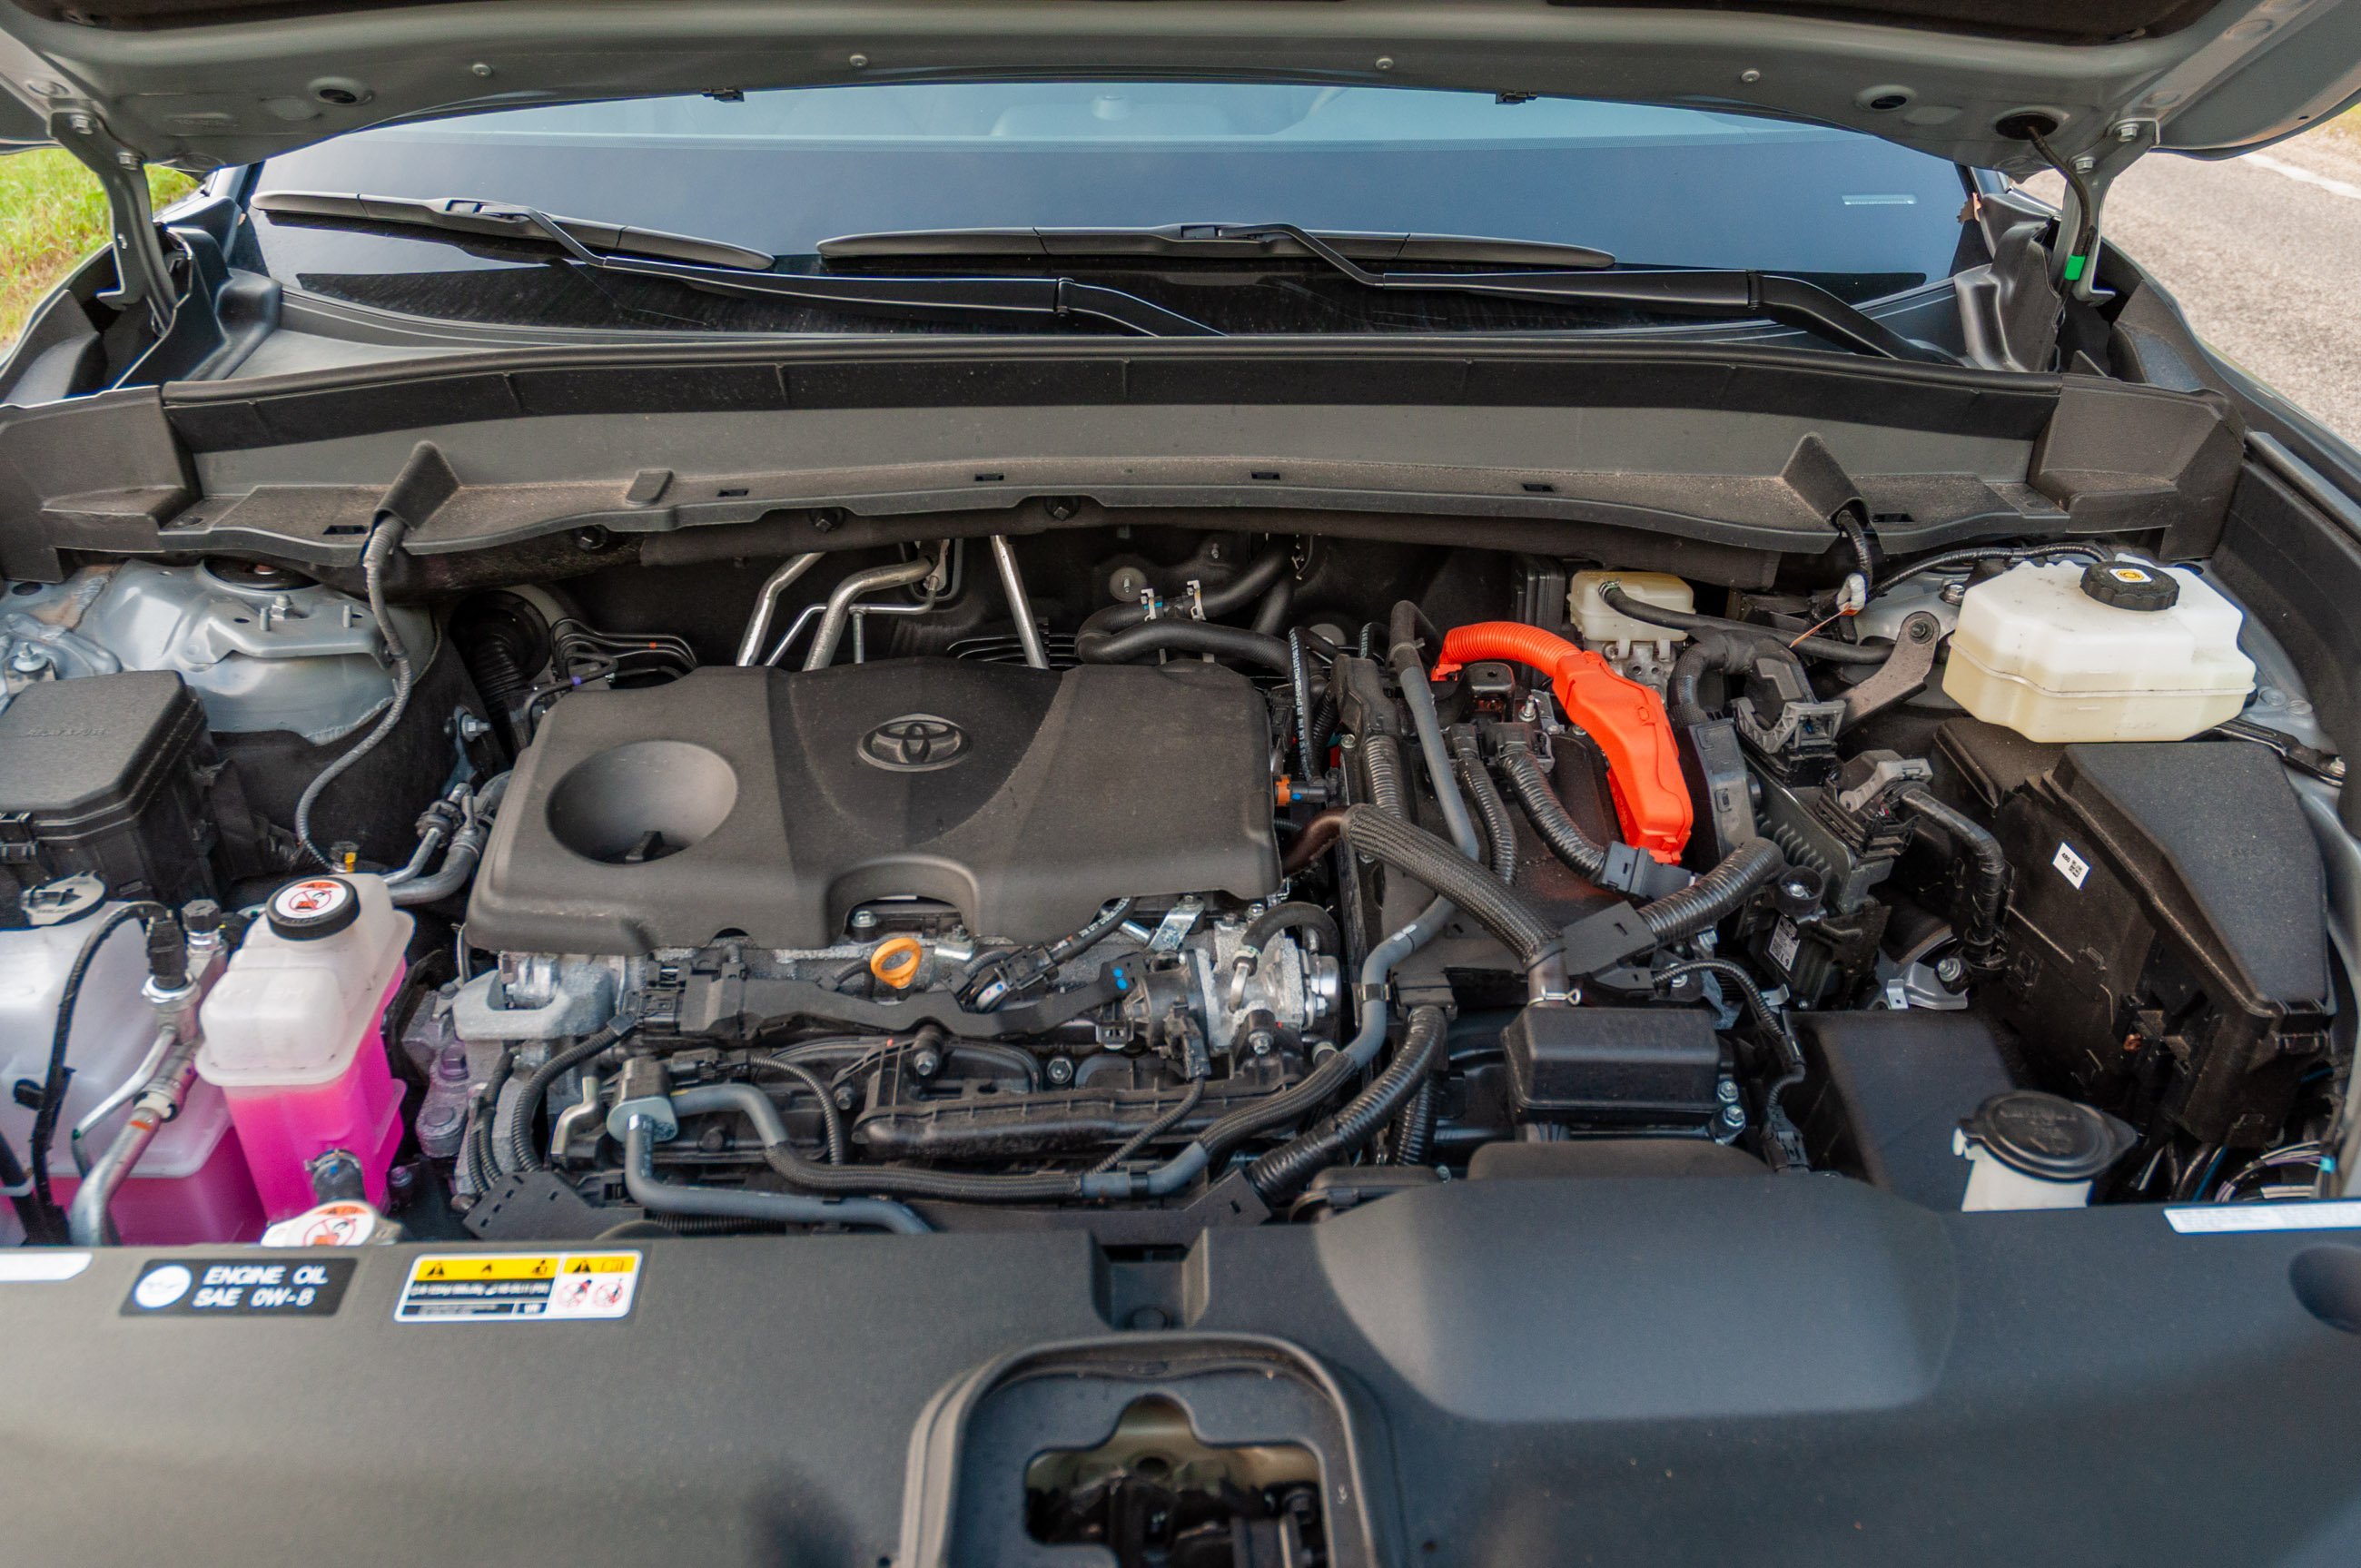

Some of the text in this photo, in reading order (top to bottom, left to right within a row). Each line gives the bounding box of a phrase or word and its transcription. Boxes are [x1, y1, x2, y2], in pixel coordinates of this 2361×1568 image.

[203, 1265, 328, 1286] ENGINE OIL
[193, 1287, 243, 1307] SAE
